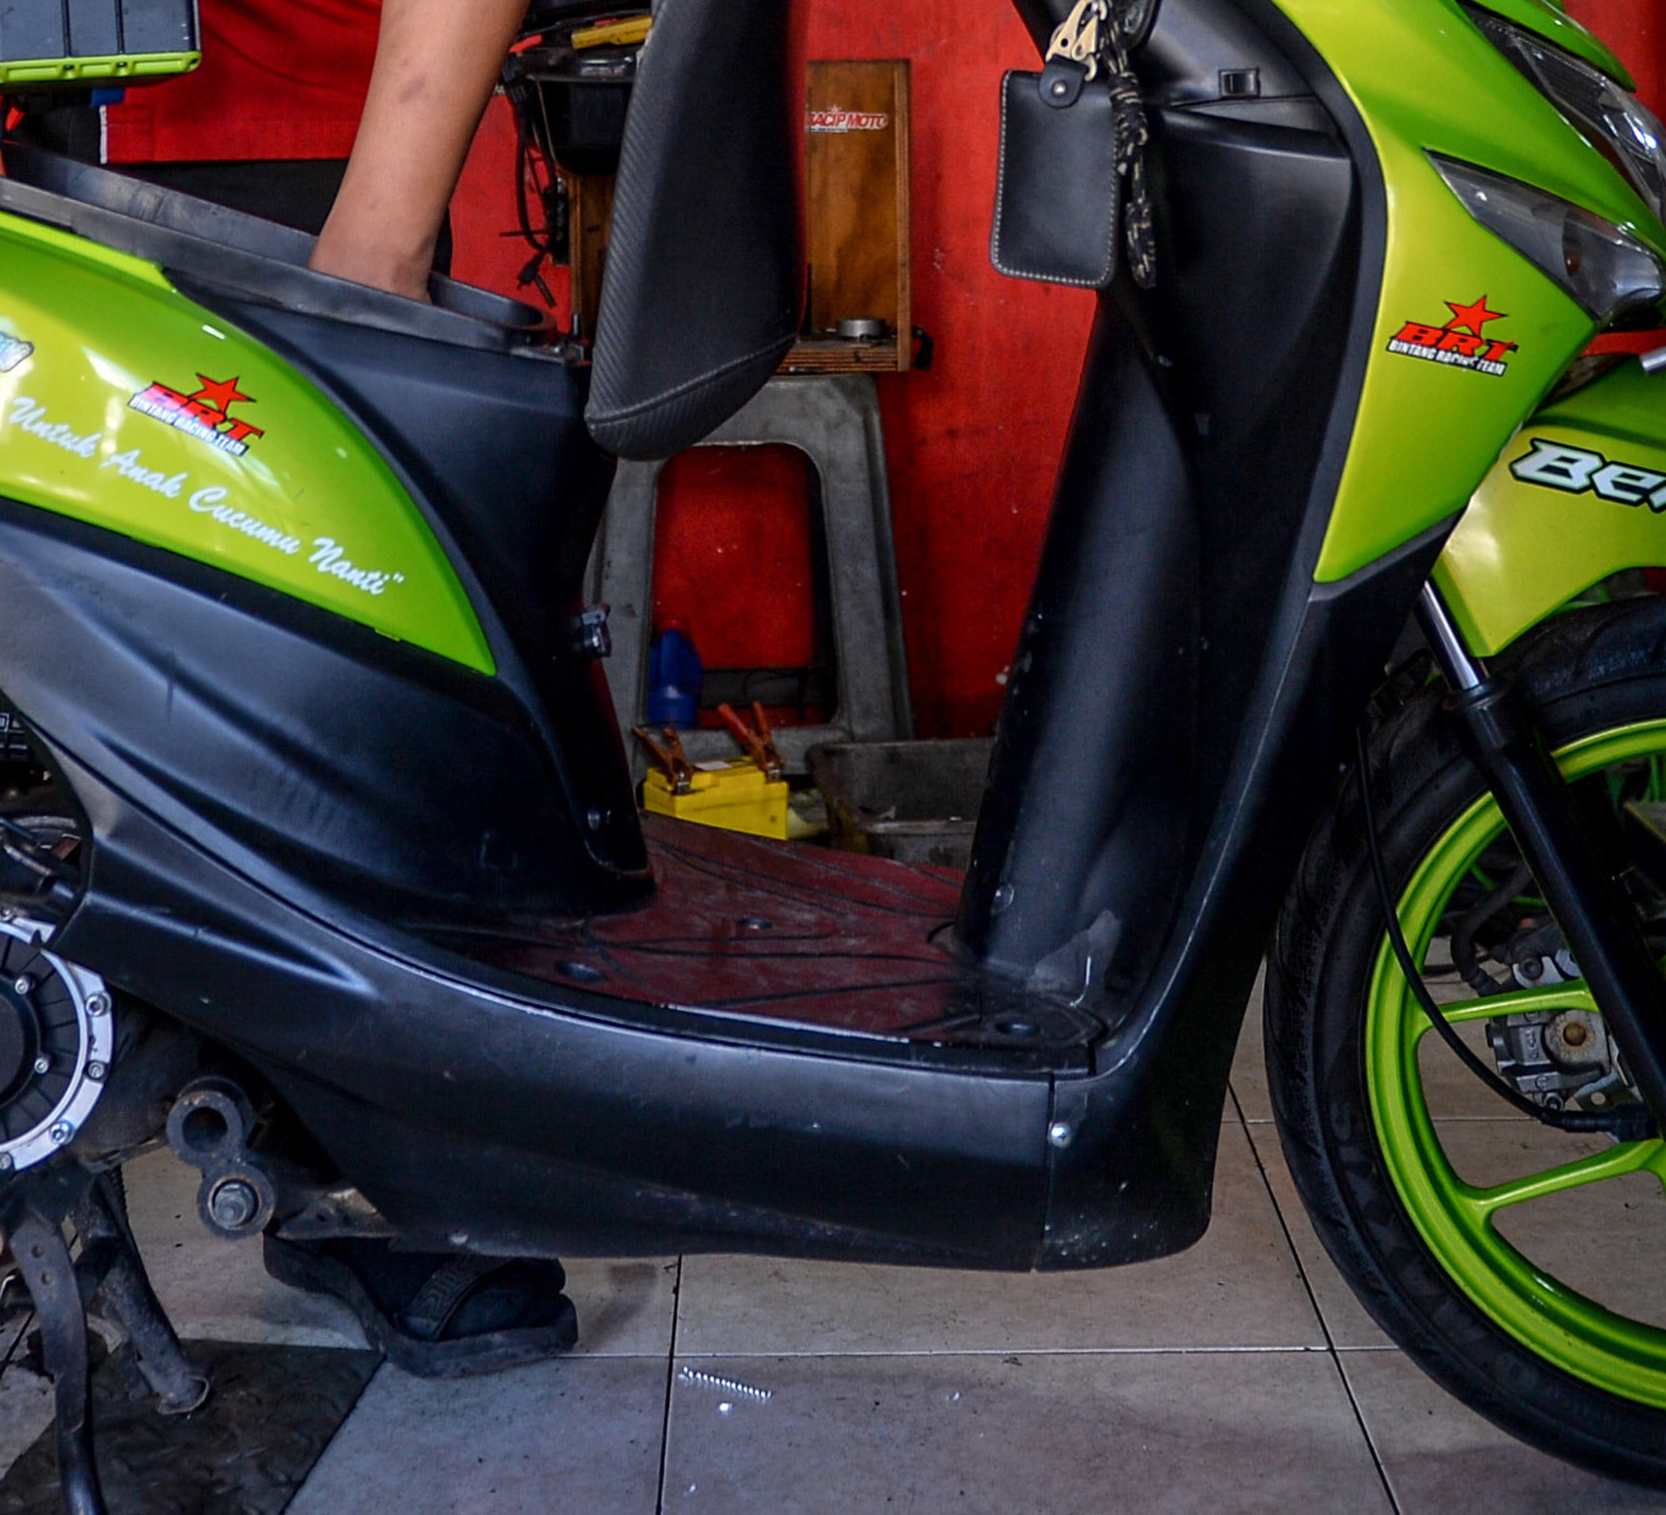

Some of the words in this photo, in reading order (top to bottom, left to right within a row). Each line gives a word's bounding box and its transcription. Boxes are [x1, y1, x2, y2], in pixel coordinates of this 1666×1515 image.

[847, 113, 888, 129] MOTO
[1388, 339, 1437, 360] BINTANG
[1476, 358, 1506, 376] TEAM
[1395, 320, 1518, 362] BRT
[129, 396, 176, 426] BINTANG
[173, 414, 218, 442] RACING
[213, 431, 247, 456] TEAM
[133, 381, 265, 442] BRT
[8, 396, 103, 459] Untuk
[99, 448, 189, 499] Anak
[188, 484, 302, 555] Cucumu
